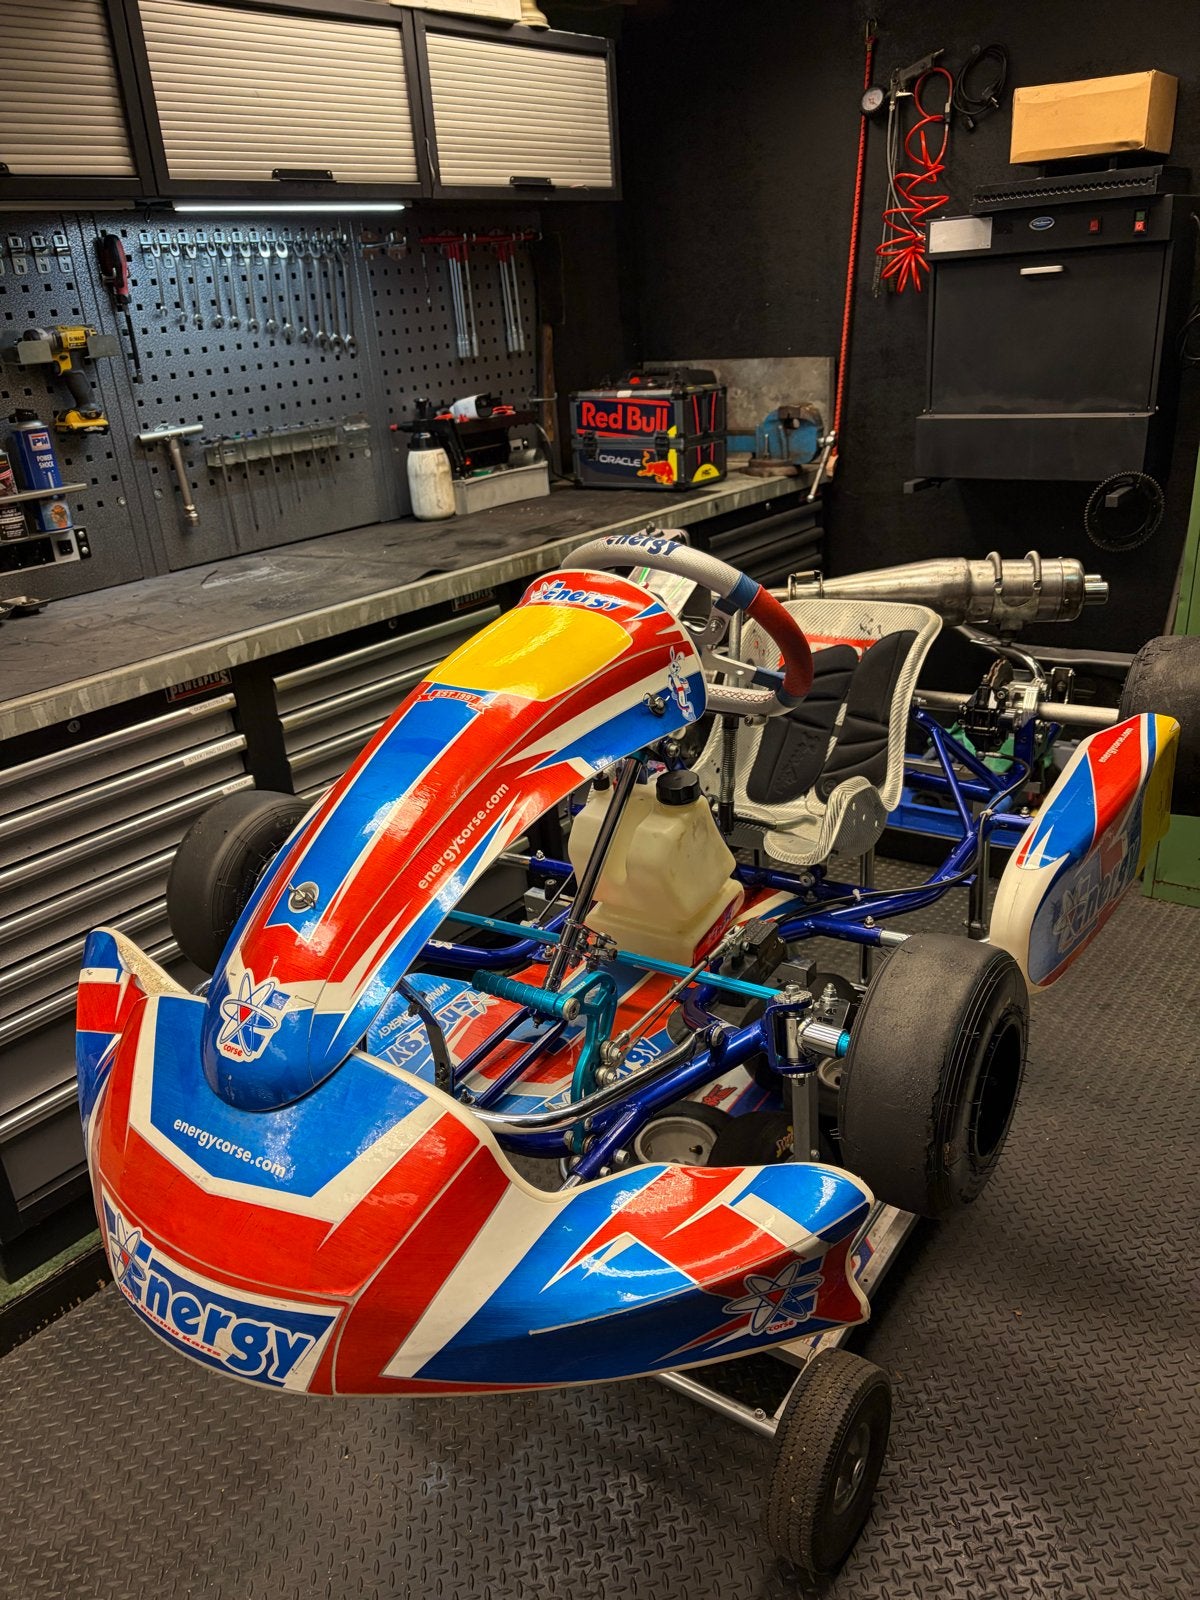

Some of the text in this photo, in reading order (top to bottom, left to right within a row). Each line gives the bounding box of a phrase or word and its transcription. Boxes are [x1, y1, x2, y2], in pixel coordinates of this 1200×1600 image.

[581, 401, 668, 433] Red Bull
[599, 453, 641, 468] ORACLE
[604, 533, 682, 557] Energy
[541, 580, 626, 611] Energy
[170, 671, 229, 698] POWERPLUS
[418, 783, 510, 890] energycorse.com
[223, 1043, 243, 1057] corse
[173, 1117, 287, 1179] energycorse.com
[118, 1239, 316, 1381] Energy
[768, 1319, 795, 1332] corse
